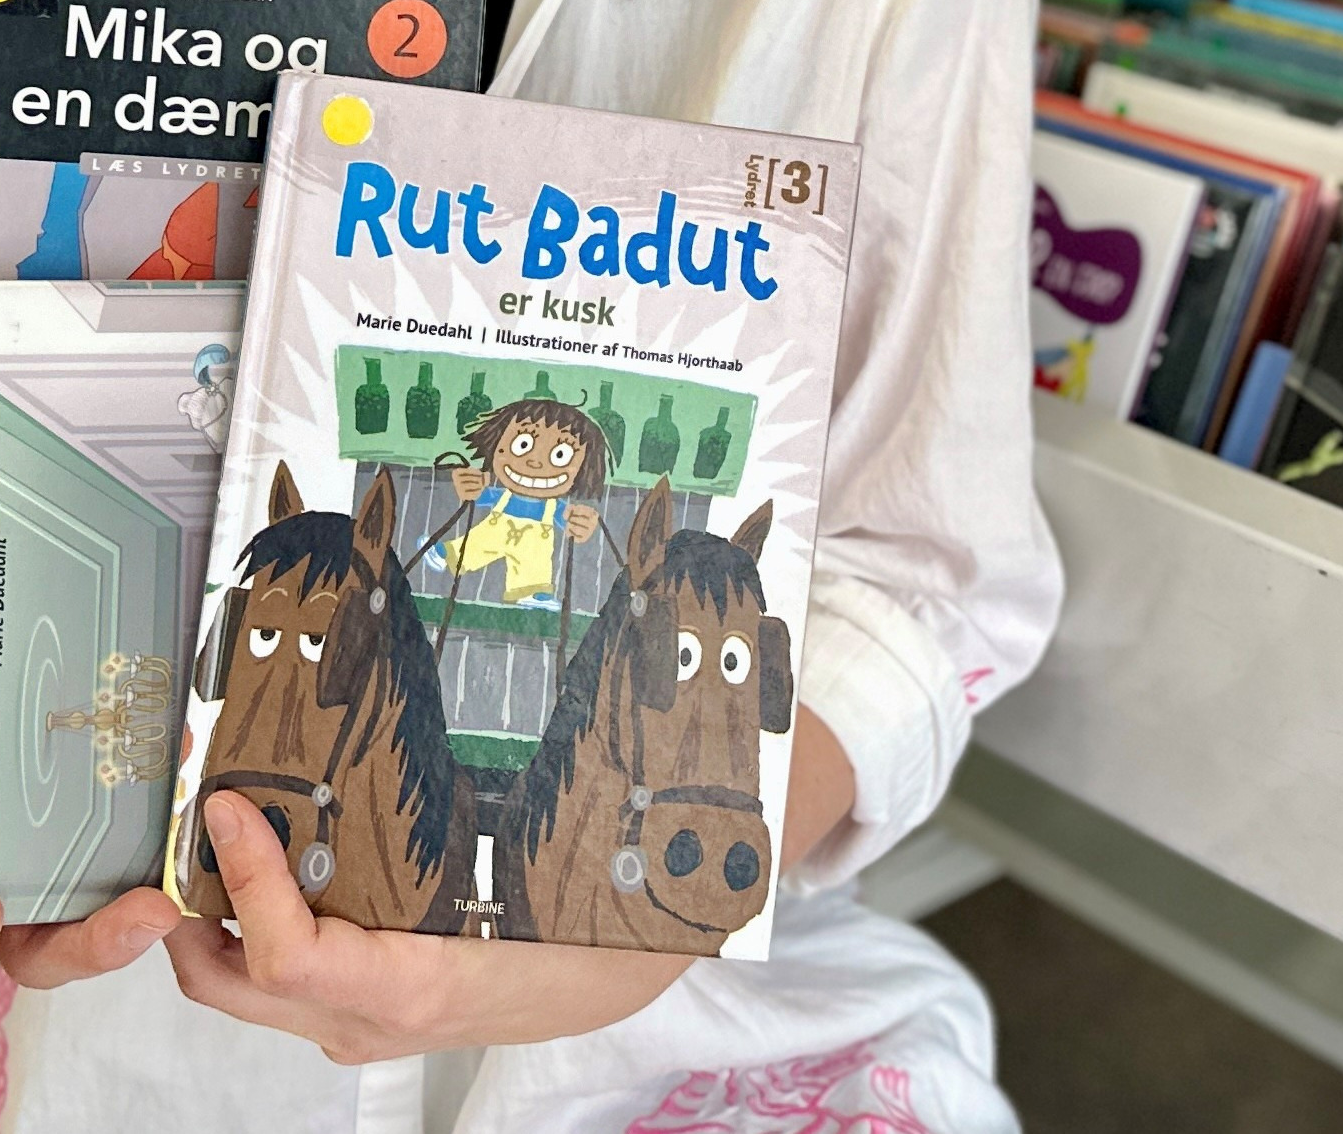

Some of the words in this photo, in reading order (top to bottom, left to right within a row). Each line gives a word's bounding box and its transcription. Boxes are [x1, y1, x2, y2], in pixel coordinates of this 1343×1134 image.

[64, 4, 223, 66] Mika
[394, 14, 419, 58] 2
[12, 85, 91, 127] en
[114, 75, 272, 138] dæm
[92, 160, 143, 174] LÆS
[162, 163, 261, 180] LYDRET
[745, 154, 762, 207] Lydret
[335, 163, 501, 265] Rut
[522, 183, 779, 300] Badut
[499, 292, 533, 316] er
[542, 289, 616, 327] kusk
[356, 314, 402, 334] Marie
[406, 319, 473, 341] Duedahl
[496, 328, 598, 356] Illustrationer
[602, 341, 620, 357] af
[623, 346, 674, 365] Thomas
[678, 350, 744, 373] Hjorthaab
[454, 899, 505, 915] TURBINE
